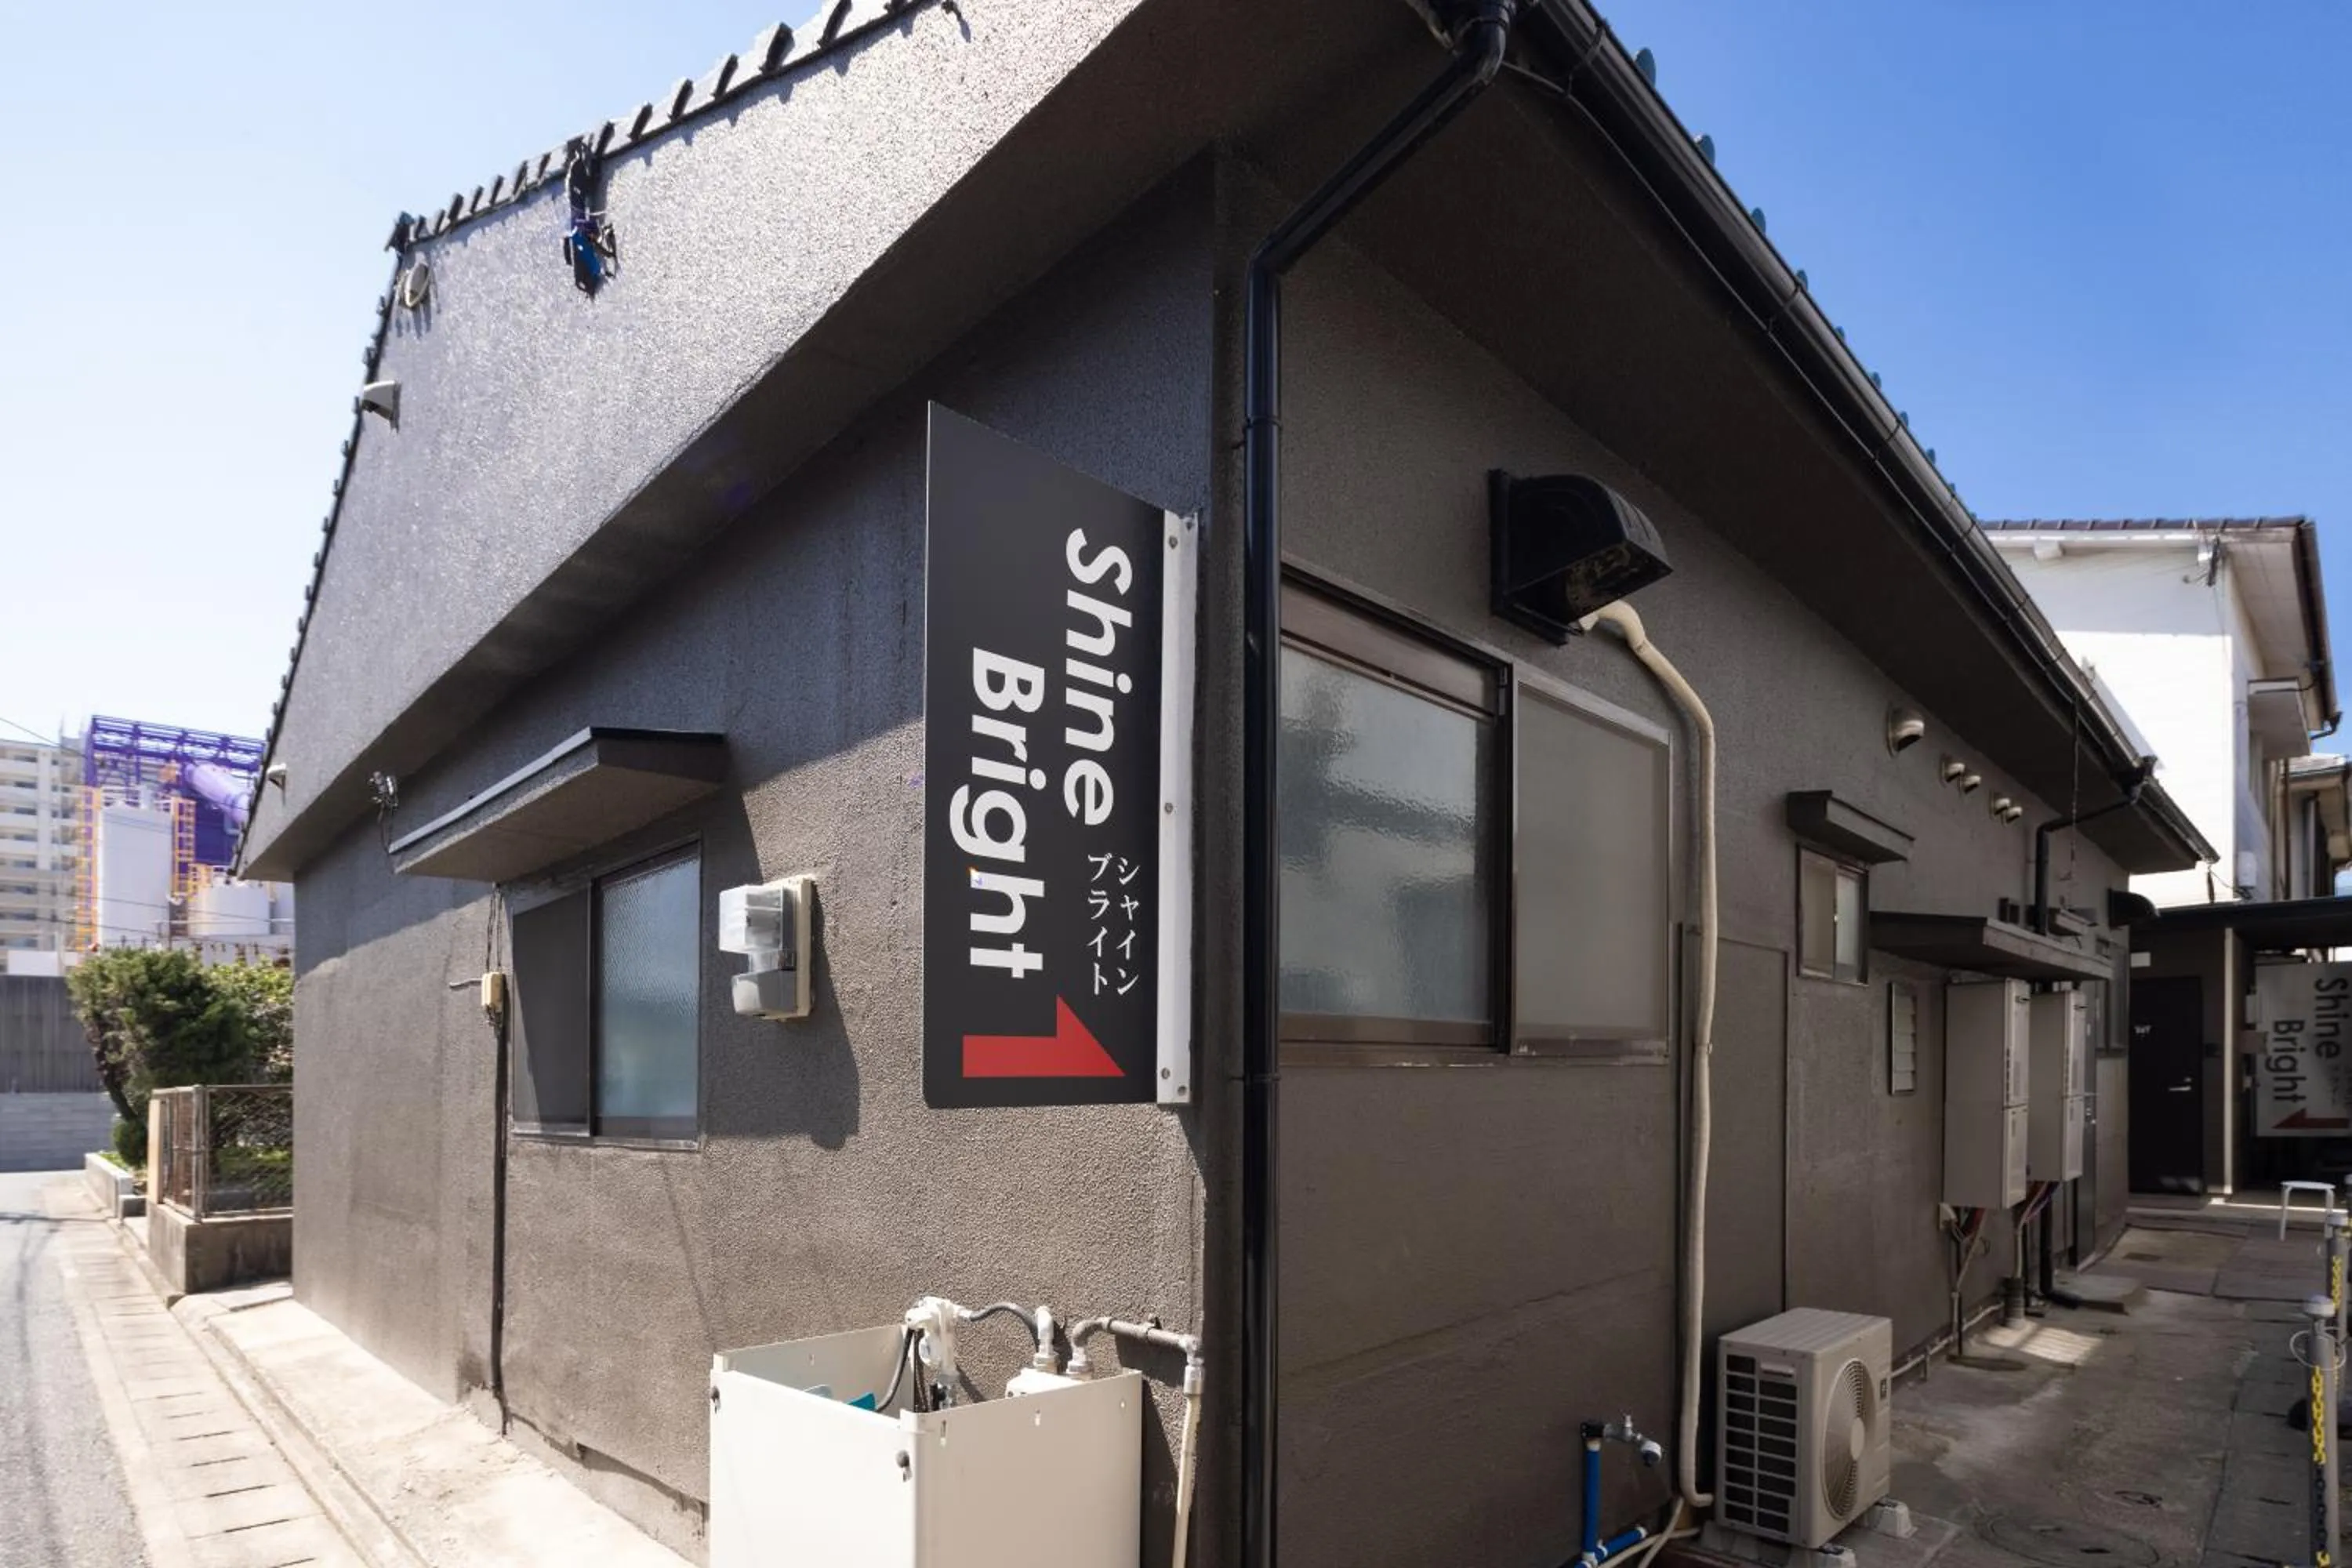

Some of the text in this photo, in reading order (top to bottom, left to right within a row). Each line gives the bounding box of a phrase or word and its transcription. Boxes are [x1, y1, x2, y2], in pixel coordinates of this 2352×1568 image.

[1064, 527, 1133, 826] Shine
[949, 648, 1046, 979] Bright
[1087, 854, 1114, 996] ブライト
[1117, 862, 1139, 996] シャイン
[2265, 1020, 2307, 1104] Bright
[2314, 977, 2350, 1058] Shine
